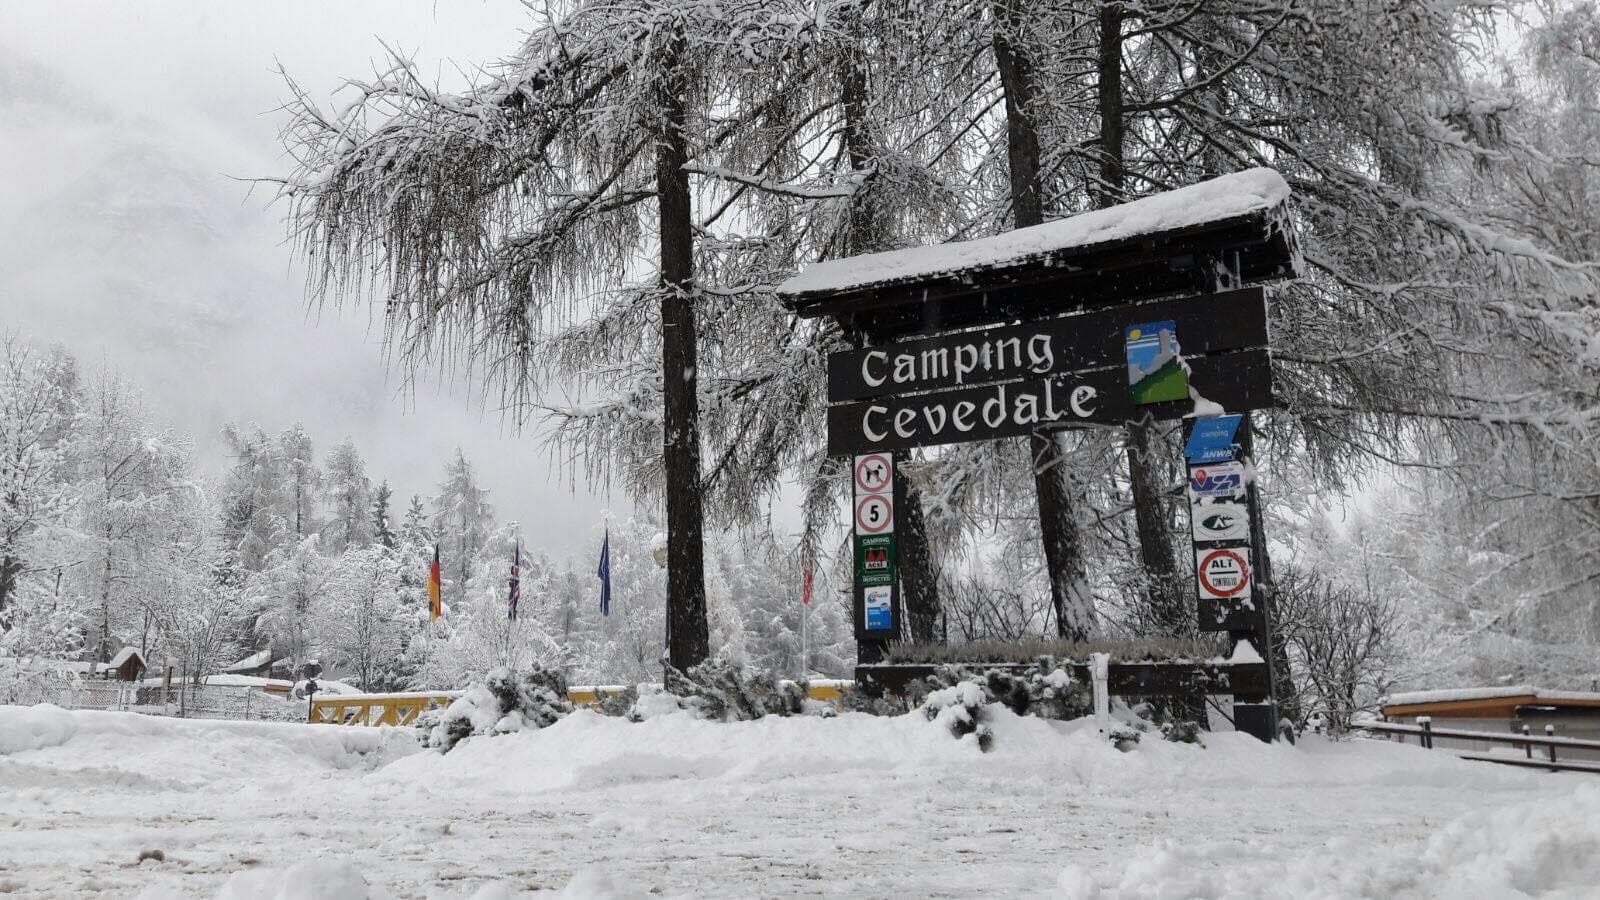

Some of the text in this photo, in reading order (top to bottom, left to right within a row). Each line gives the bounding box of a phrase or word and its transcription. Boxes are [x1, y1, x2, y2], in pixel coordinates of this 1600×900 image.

[862, 334, 1054, 387] Camping
[863, 378, 1098, 442] Cevedale
[1202, 450, 1233, 459] ANWB
[870, 505, 879, 522] 5
[863, 537, 890, 545] CAMPING
[1211, 559, 1233, 568] ALT
